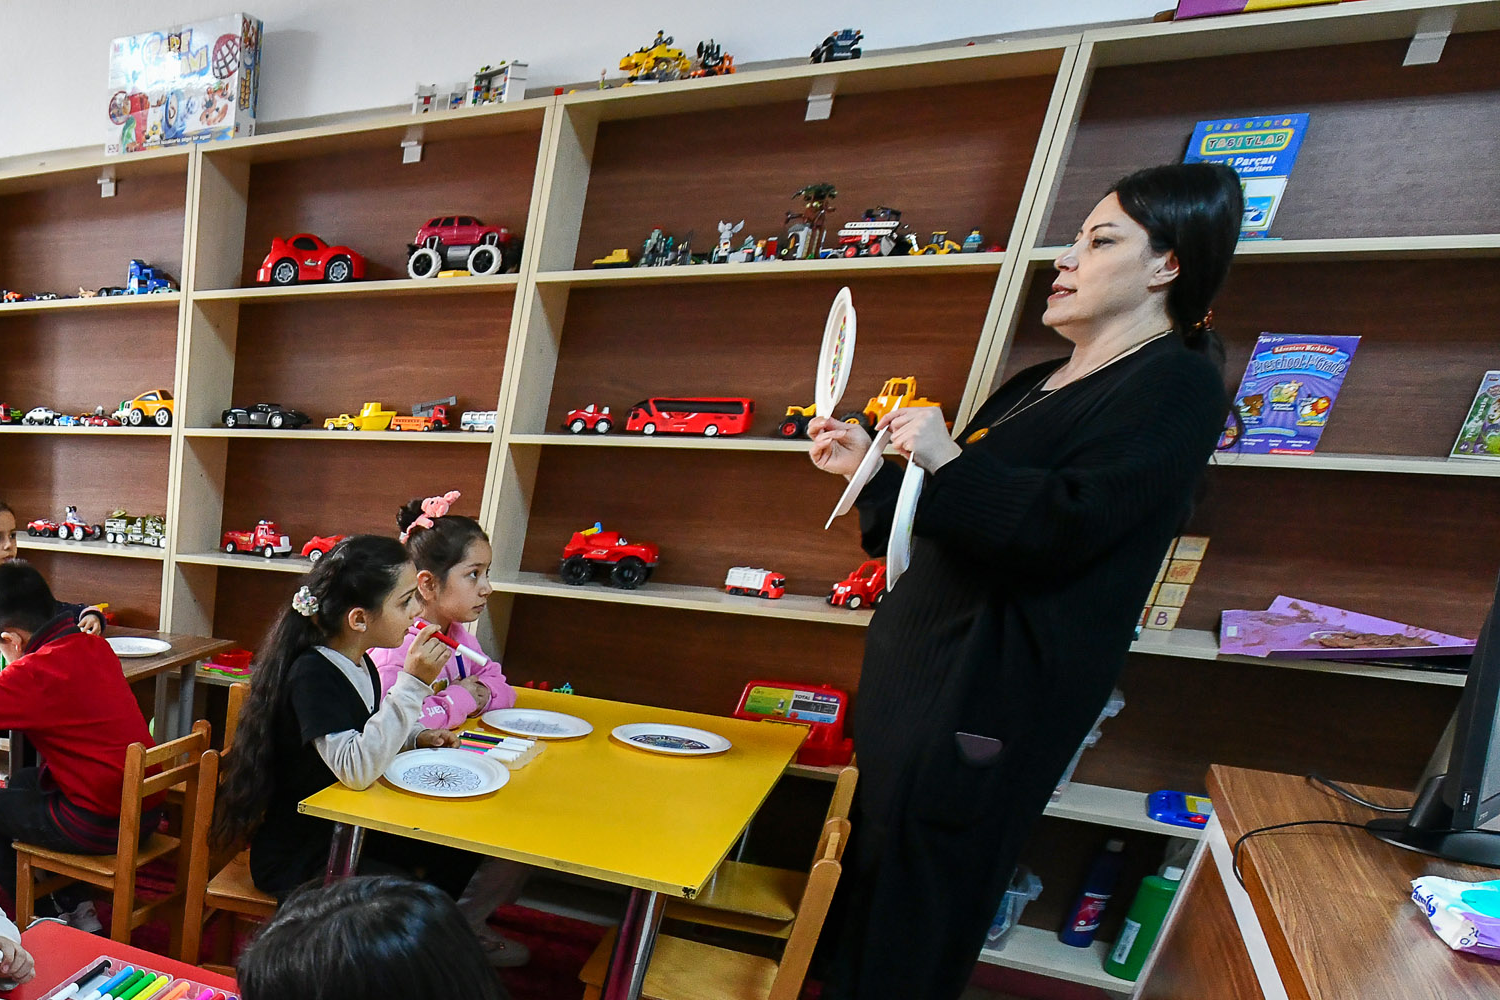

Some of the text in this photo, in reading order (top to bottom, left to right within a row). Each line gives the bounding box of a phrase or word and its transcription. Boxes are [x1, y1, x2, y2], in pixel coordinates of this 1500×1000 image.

[1234, 154, 1278, 168] Parçalı
[1315, 356, 1346, 376] Grade
[1154, 610, 1169, 626] B
